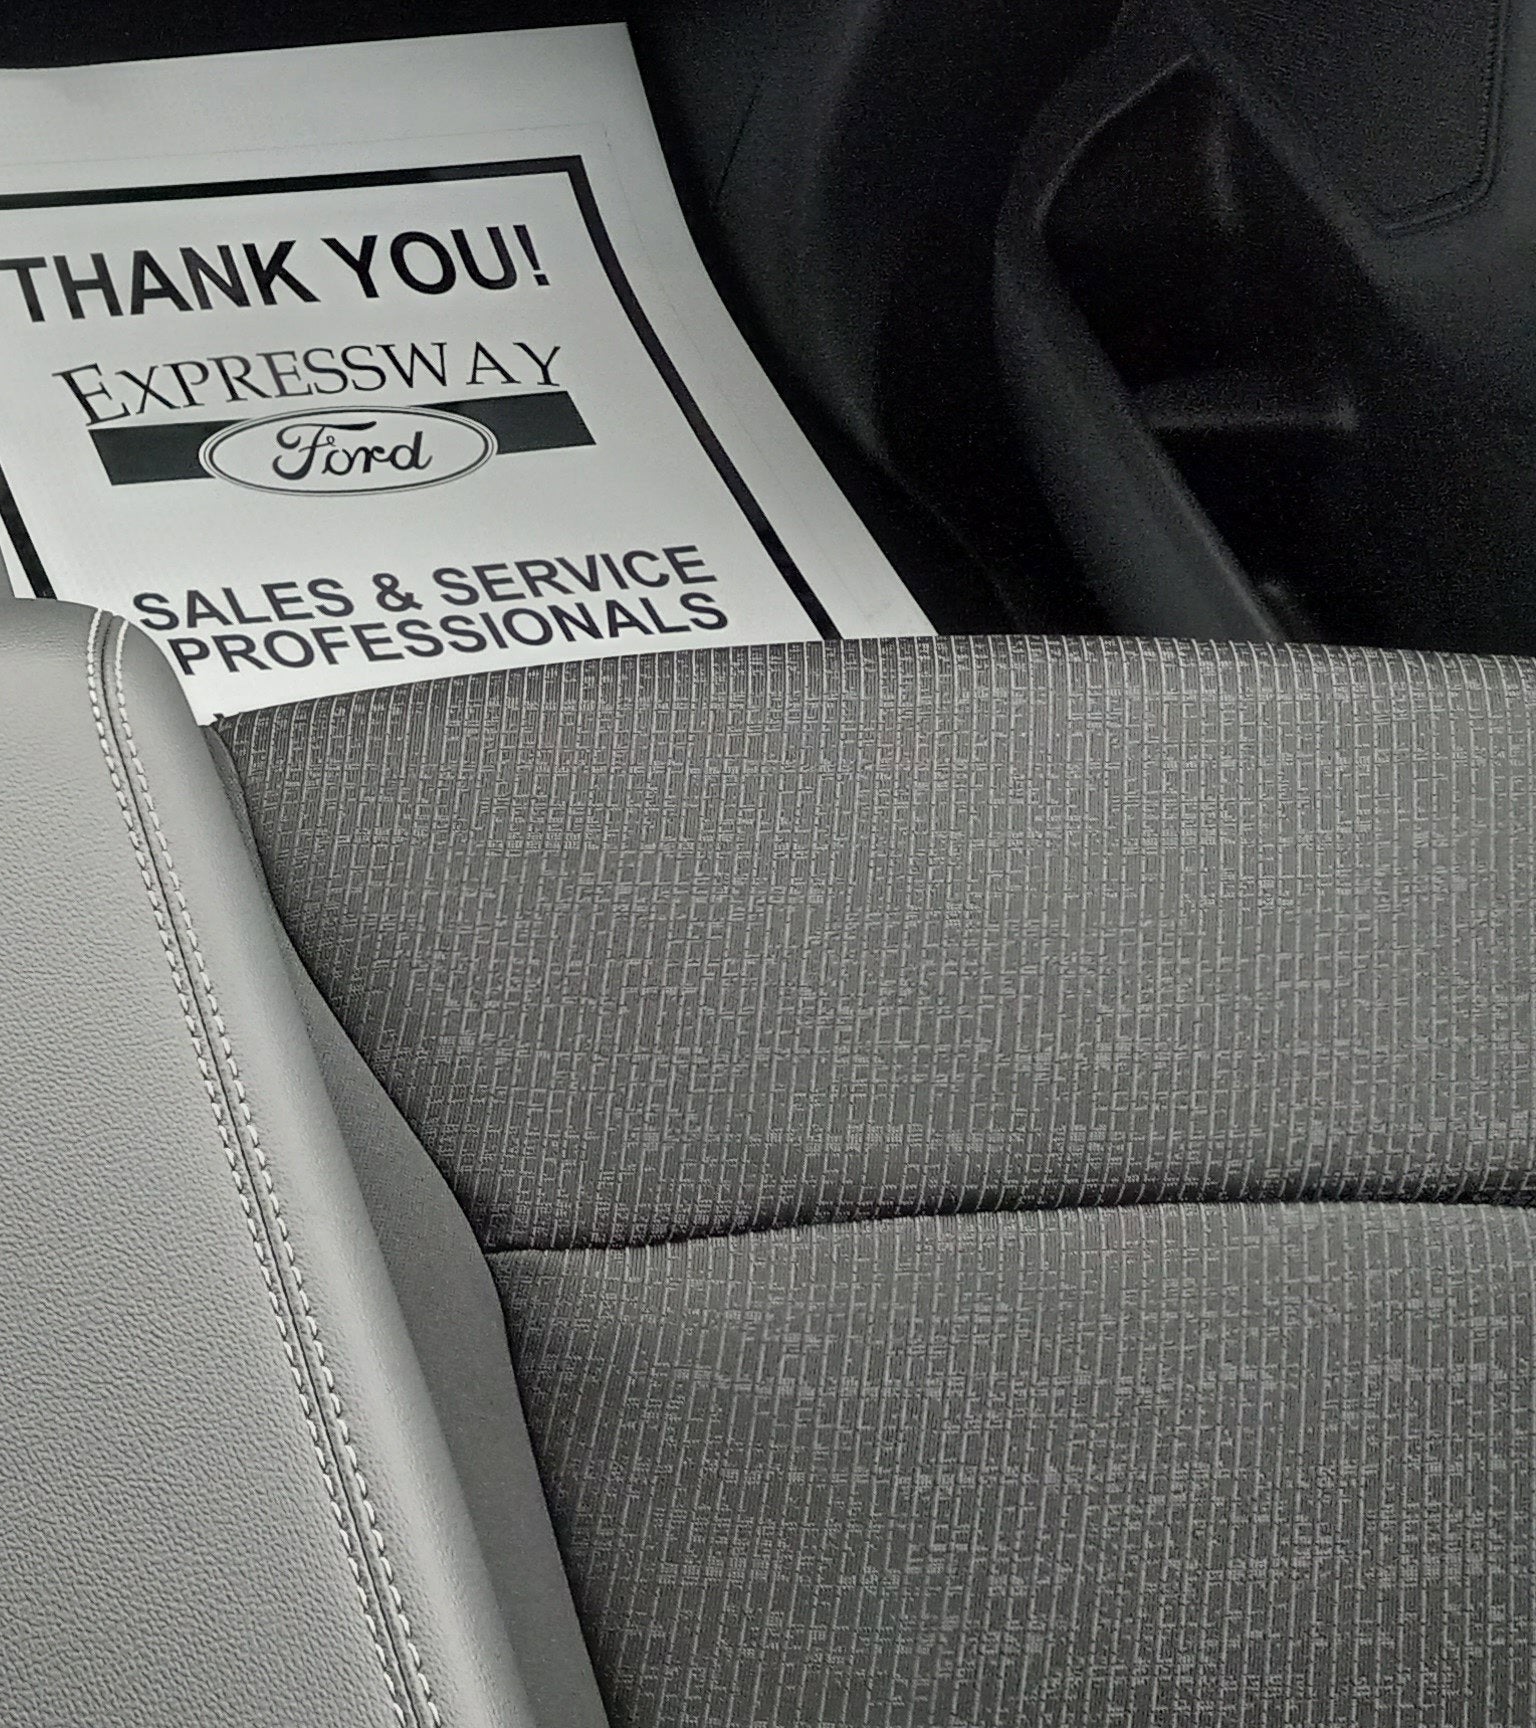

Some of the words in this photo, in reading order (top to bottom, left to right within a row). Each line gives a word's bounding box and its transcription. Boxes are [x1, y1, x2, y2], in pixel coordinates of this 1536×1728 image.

[324, 224, 552, 305] YOU!
[51, 338, 566, 426] EXPRESSWAY
[271, 420, 435, 480] Ford
[133, 572, 355, 632] SALES
[375, 570, 425, 614] &
[432, 544, 718, 605] SERVICE
[163, 592, 729, 677] PROFESSIONALS
